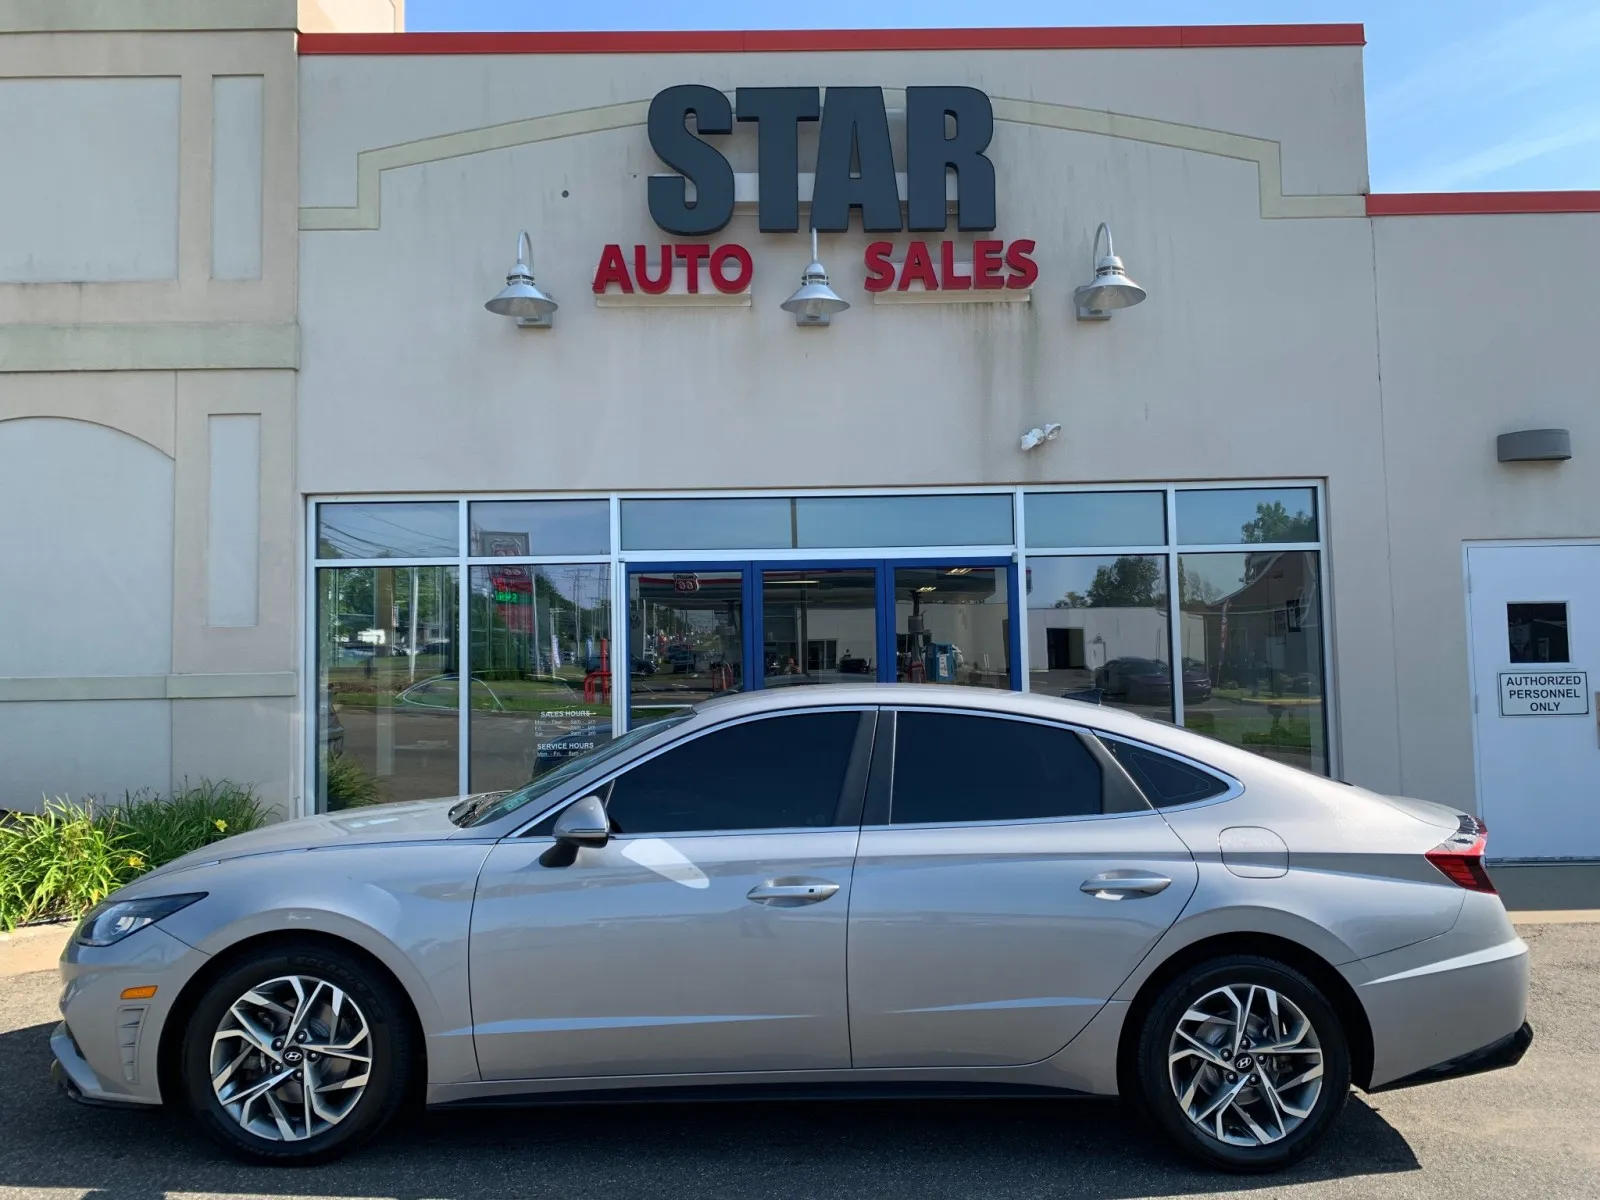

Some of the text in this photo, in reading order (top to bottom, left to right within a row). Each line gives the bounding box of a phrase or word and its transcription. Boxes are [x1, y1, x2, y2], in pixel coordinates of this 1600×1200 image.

[647, 84, 996, 236] STAR
[592, 239, 1038, 295] AUTO SALES
[1506, 676, 1581, 686] AUTHORIZED
[1509, 689, 1580, 699] PERSONNEL
[1530, 702, 1560, 711] ONLY
